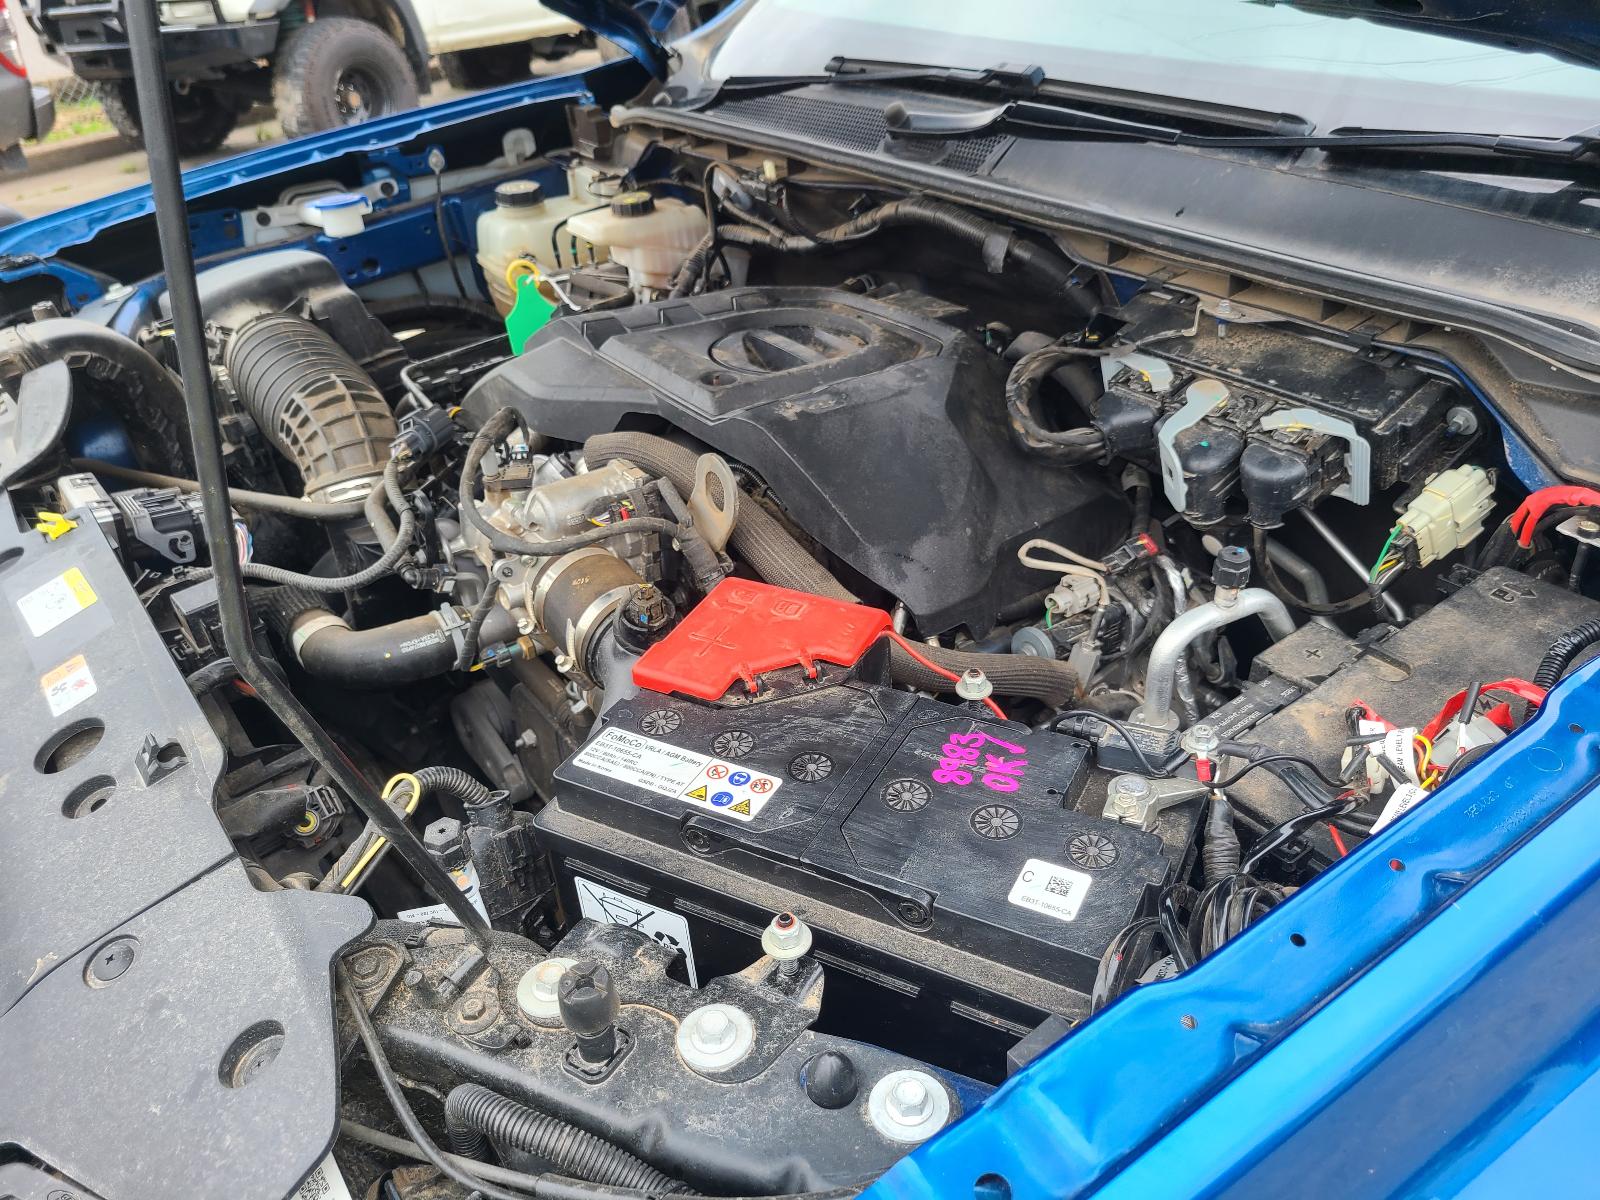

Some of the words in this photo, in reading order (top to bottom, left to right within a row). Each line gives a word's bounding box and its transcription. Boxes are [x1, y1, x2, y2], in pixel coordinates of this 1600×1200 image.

[605, 731, 642, 748] FoMoCo
[645, 744, 662, 754] VRLA
[664, 751, 682, 760] AGM
[680, 755, 704, 768] Battery
[932, 732, 986, 786] 8983
[1022, 870, 1035, 883] C
[1021, 895, 1072, 916] EB3T-10655-CA
